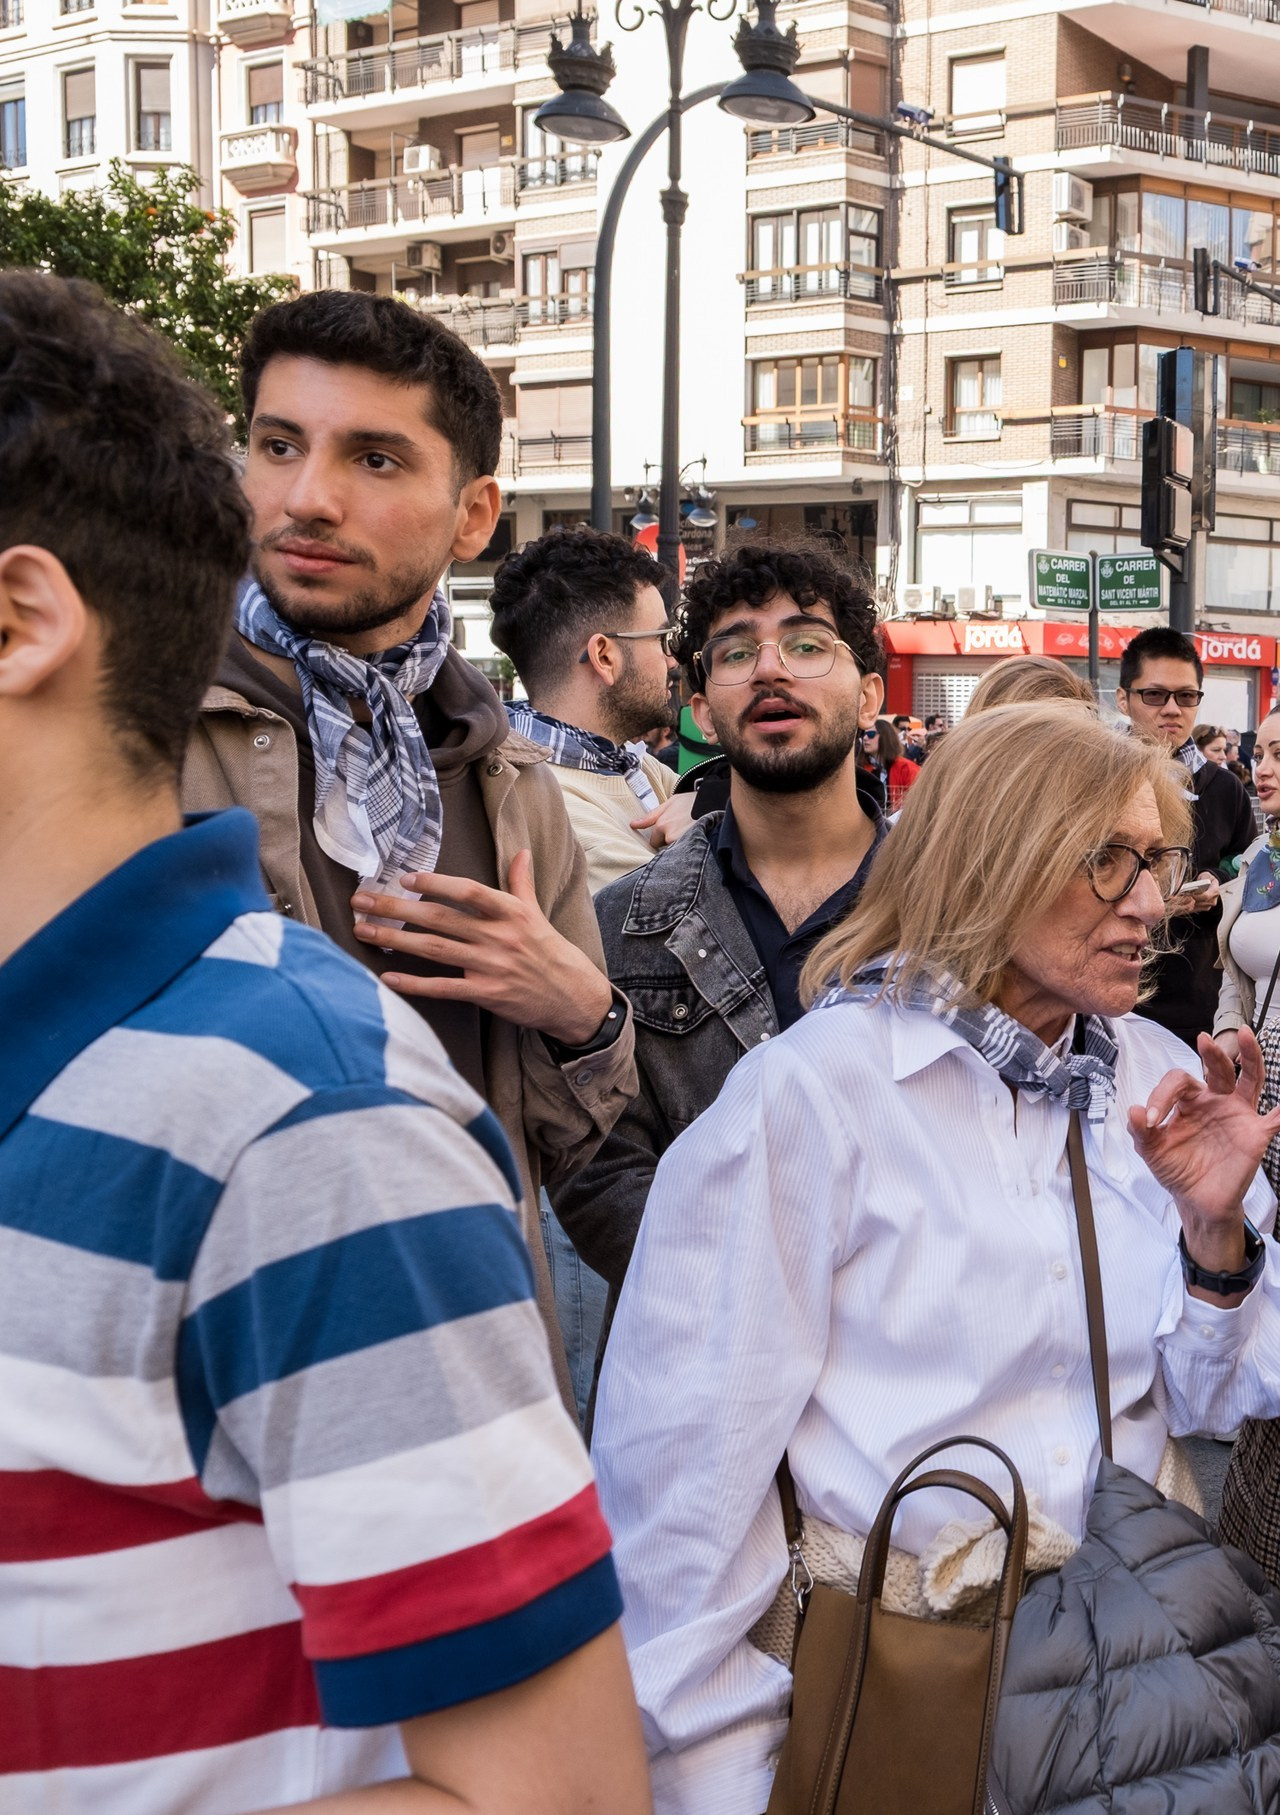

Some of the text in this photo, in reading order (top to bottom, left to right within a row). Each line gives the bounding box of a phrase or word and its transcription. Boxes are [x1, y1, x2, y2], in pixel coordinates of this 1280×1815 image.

[1050, 558, 1086, 572] CARRER
[1115, 559, 1157, 572] CARRER
[1056, 573, 1070, 584] DEL
[1123, 575, 1135, 585] DE
[1068, 588, 1088, 599] MARZAL
[1101, 588, 1116, 600] SANT
[1116, 588, 1137, 600] VICENT
[1200, 635, 1262, 661] jordá
